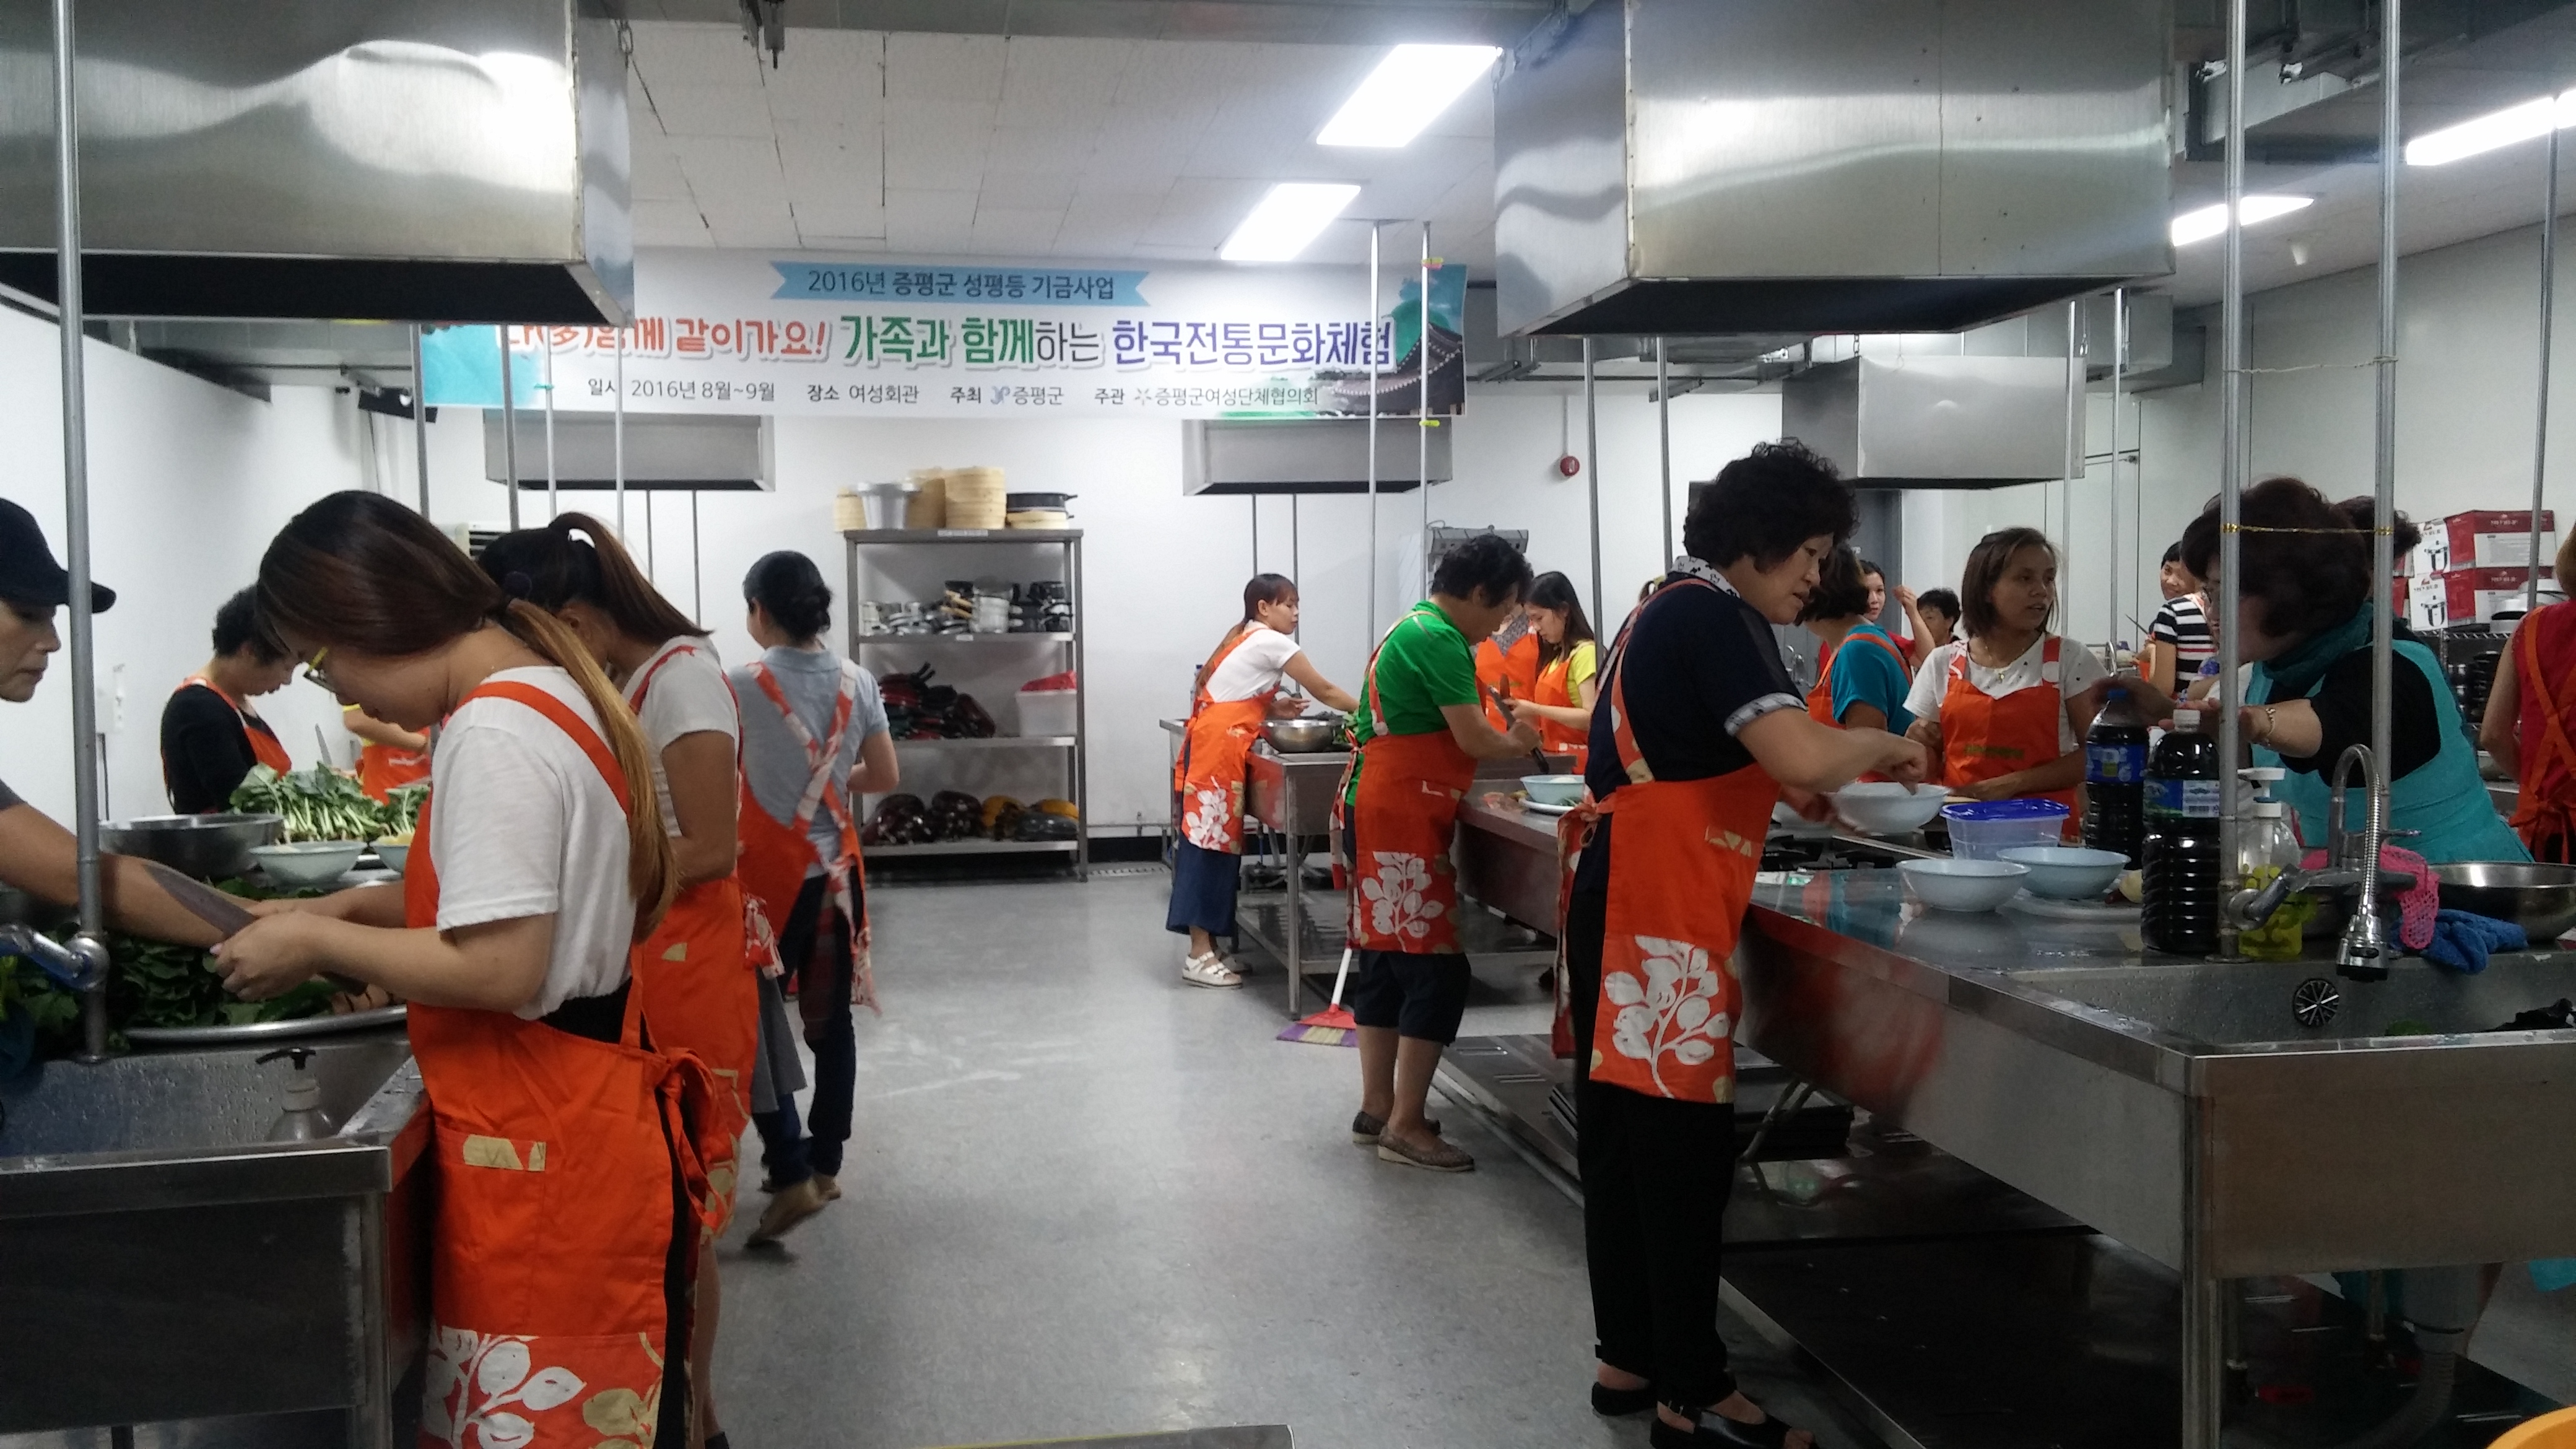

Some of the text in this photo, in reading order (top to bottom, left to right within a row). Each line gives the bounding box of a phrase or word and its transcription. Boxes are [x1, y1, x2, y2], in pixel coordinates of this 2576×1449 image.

[808, 270, 1114, 300] 2016년 증평군 성평등 기금사업
[676, 318, 826, 354] 같이가요!
[840, 315, 950, 362] 가족과
[961, 317, 1100, 363] 함께하는
[1112, 320, 1391, 365] 한국전통문화체험
[631, 380, 695, 400] 2016년
[702, 381, 774, 402] 8월~9월
[807, 384, 840, 402] 장소
[849, 384, 920, 404] 여성회관
[950, 386, 981, 404] 주최
[1012, 386, 1064, 406] 증평군
[1094, 388, 1125, 405] 주관
[1154, 388, 1318, 406] 증평군여성단체협의회
